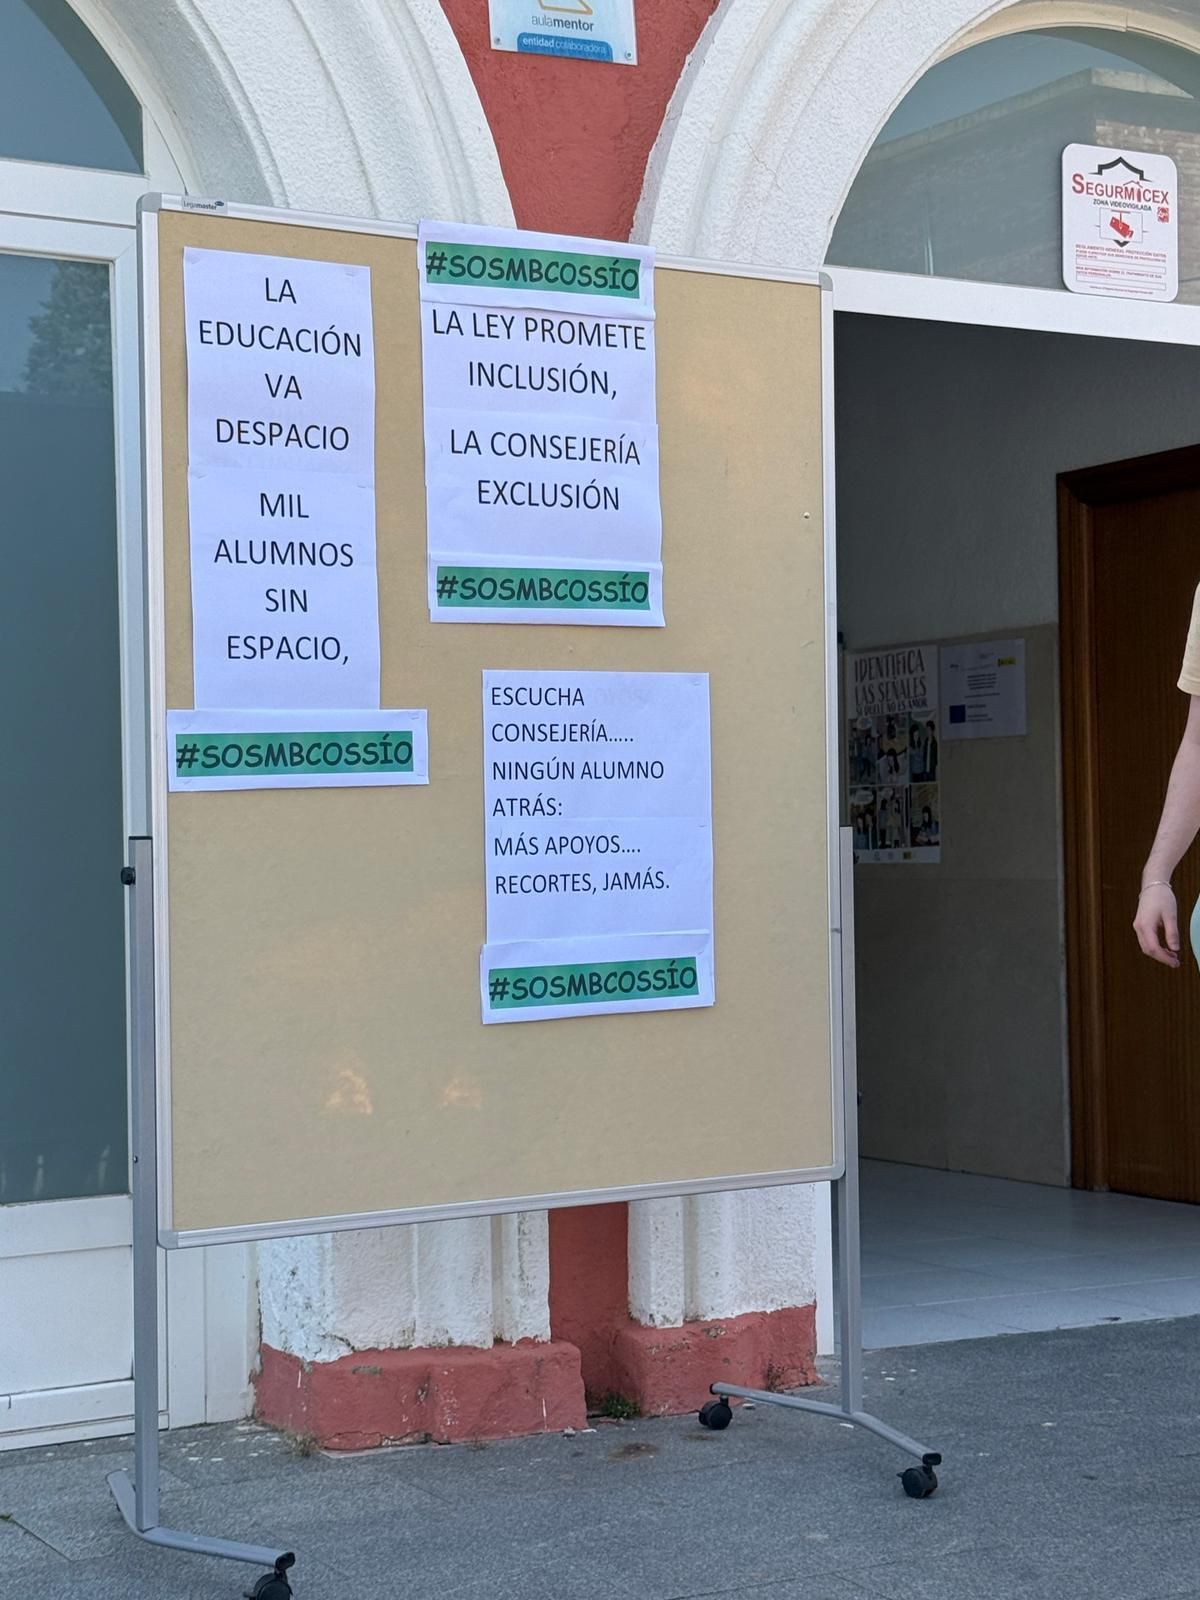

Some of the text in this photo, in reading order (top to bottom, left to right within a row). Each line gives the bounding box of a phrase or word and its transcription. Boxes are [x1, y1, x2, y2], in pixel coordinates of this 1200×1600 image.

[532, 14, 594, 32] aulamentor
[523, 37, 607, 54] entidad colaboradora
[1072, 173, 1169, 206] SEGURMICEX
[183, 200, 217, 211] Legamaster
[1093, 198, 1152, 212] ZONA VIDEOVIGILADA
[426, 250, 639, 292] #SOSMBCOSSÍO
[265, 277, 297, 305] LA
[199, 319, 361, 358] EDUCACIÓN
[432, 309, 647, 351] LA LEY PROMETE
[264, 372, 303, 401] VA
[469, 360, 617, 401] INCLUSIÓN,
[216, 418, 350, 451] DESPACIO
[450, 428, 641, 466] LA CONSEJERÍA
[259, 492, 310, 519] MIL
[477, 478, 620, 511] EXCLUSIÓN
[213, 538, 354, 568] ALUMNOS
[265, 588, 308, 613] SIN
[437, 573, 649, 604] #SOSMBCOSSÍO
[227, 635, 349, 666] ESPACIO,
[854, 648, 925, 684] IDENTIFICA
[491, 686, 585, 707] ESCUCHA
[854, 676, 928, 706] LAS SEÑALES
[176, 733, 413, 769] #SOSMBCOSSÍO
[492, 755, 665, 781] NINGÚN ALUMNO
[492, 792, 563, 817] ATRÁS:
[494, 834, 539, 857] MÁS
[495, 867, 670, 896] RECORTES, JAMÁS.
[489, 961, 697, 1001] #SOSMBCOSSÍO
